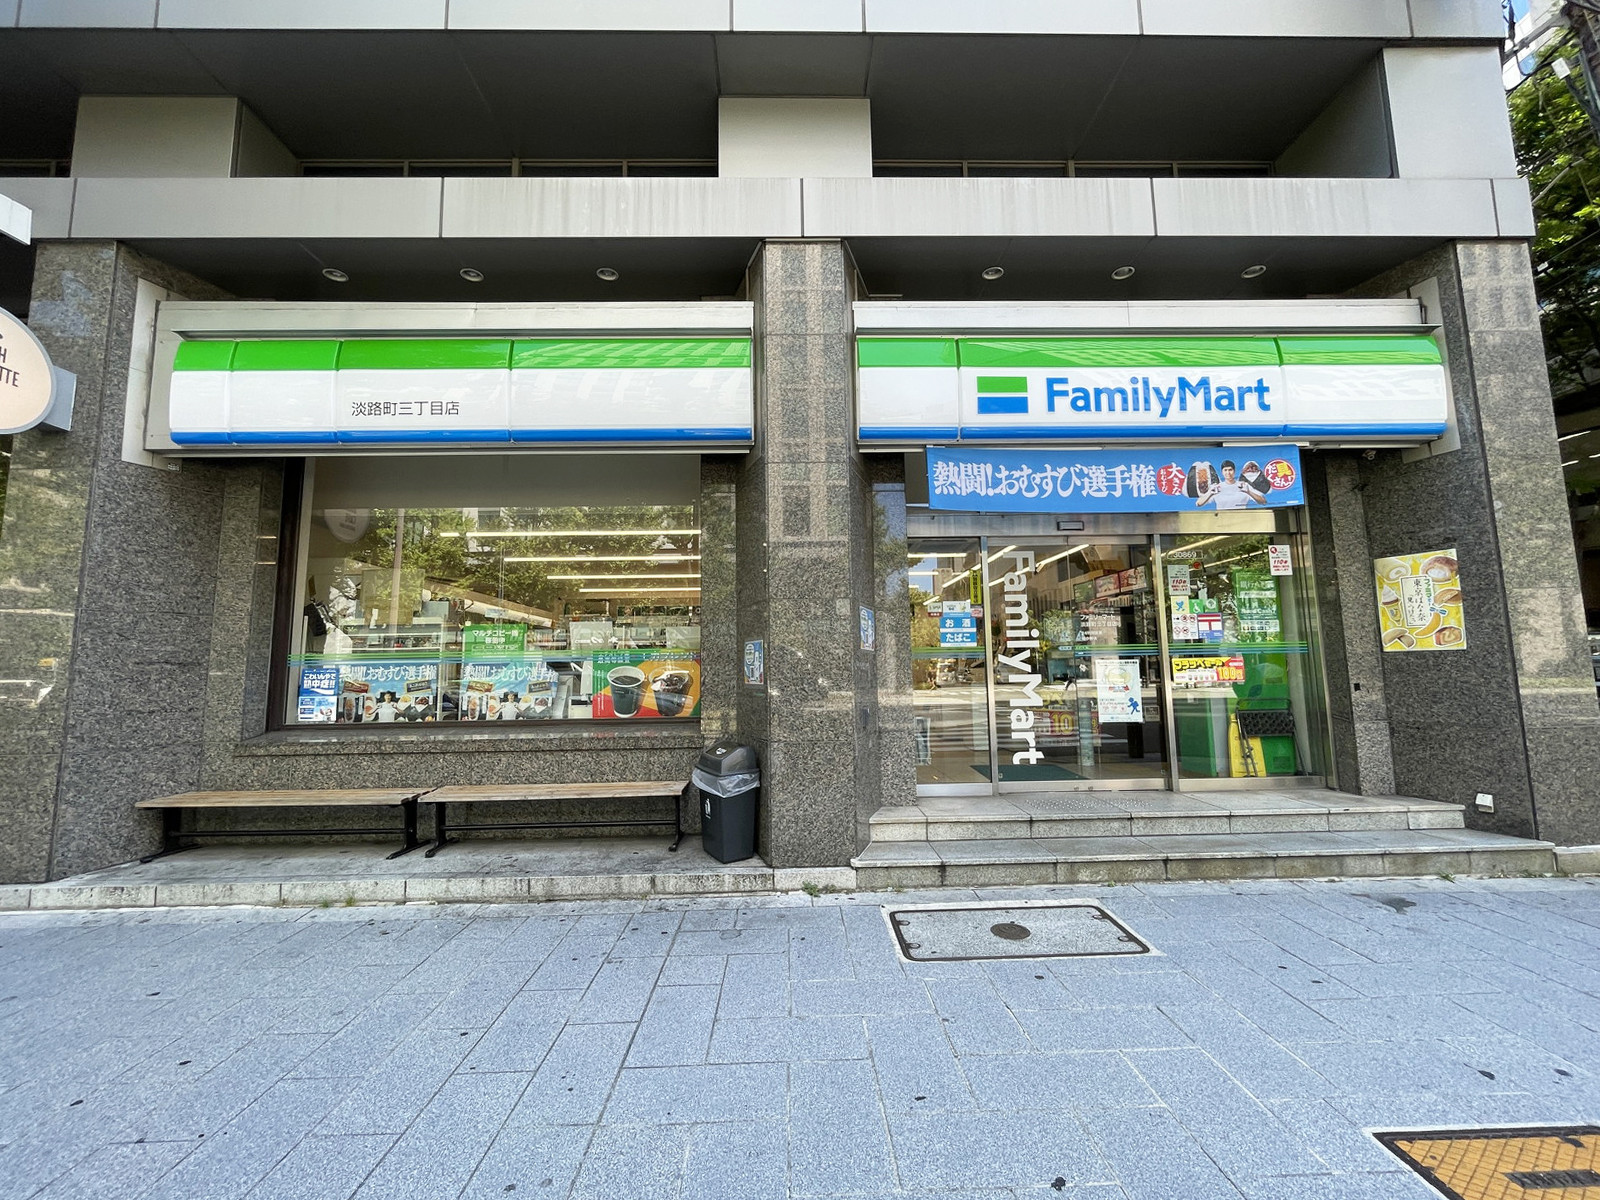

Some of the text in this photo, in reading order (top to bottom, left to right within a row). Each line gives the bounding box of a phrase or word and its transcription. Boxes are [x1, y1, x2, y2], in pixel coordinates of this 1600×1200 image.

[351, 401, 460, 417] 淡路町三丁目店
[1046, 376, 1271, 418] FamilyMart
[1167, 461, 1186, 496] 大きな
[945, 632, 972, 643] たばこ
[998, 550, 1045, 765] FamilyMart
